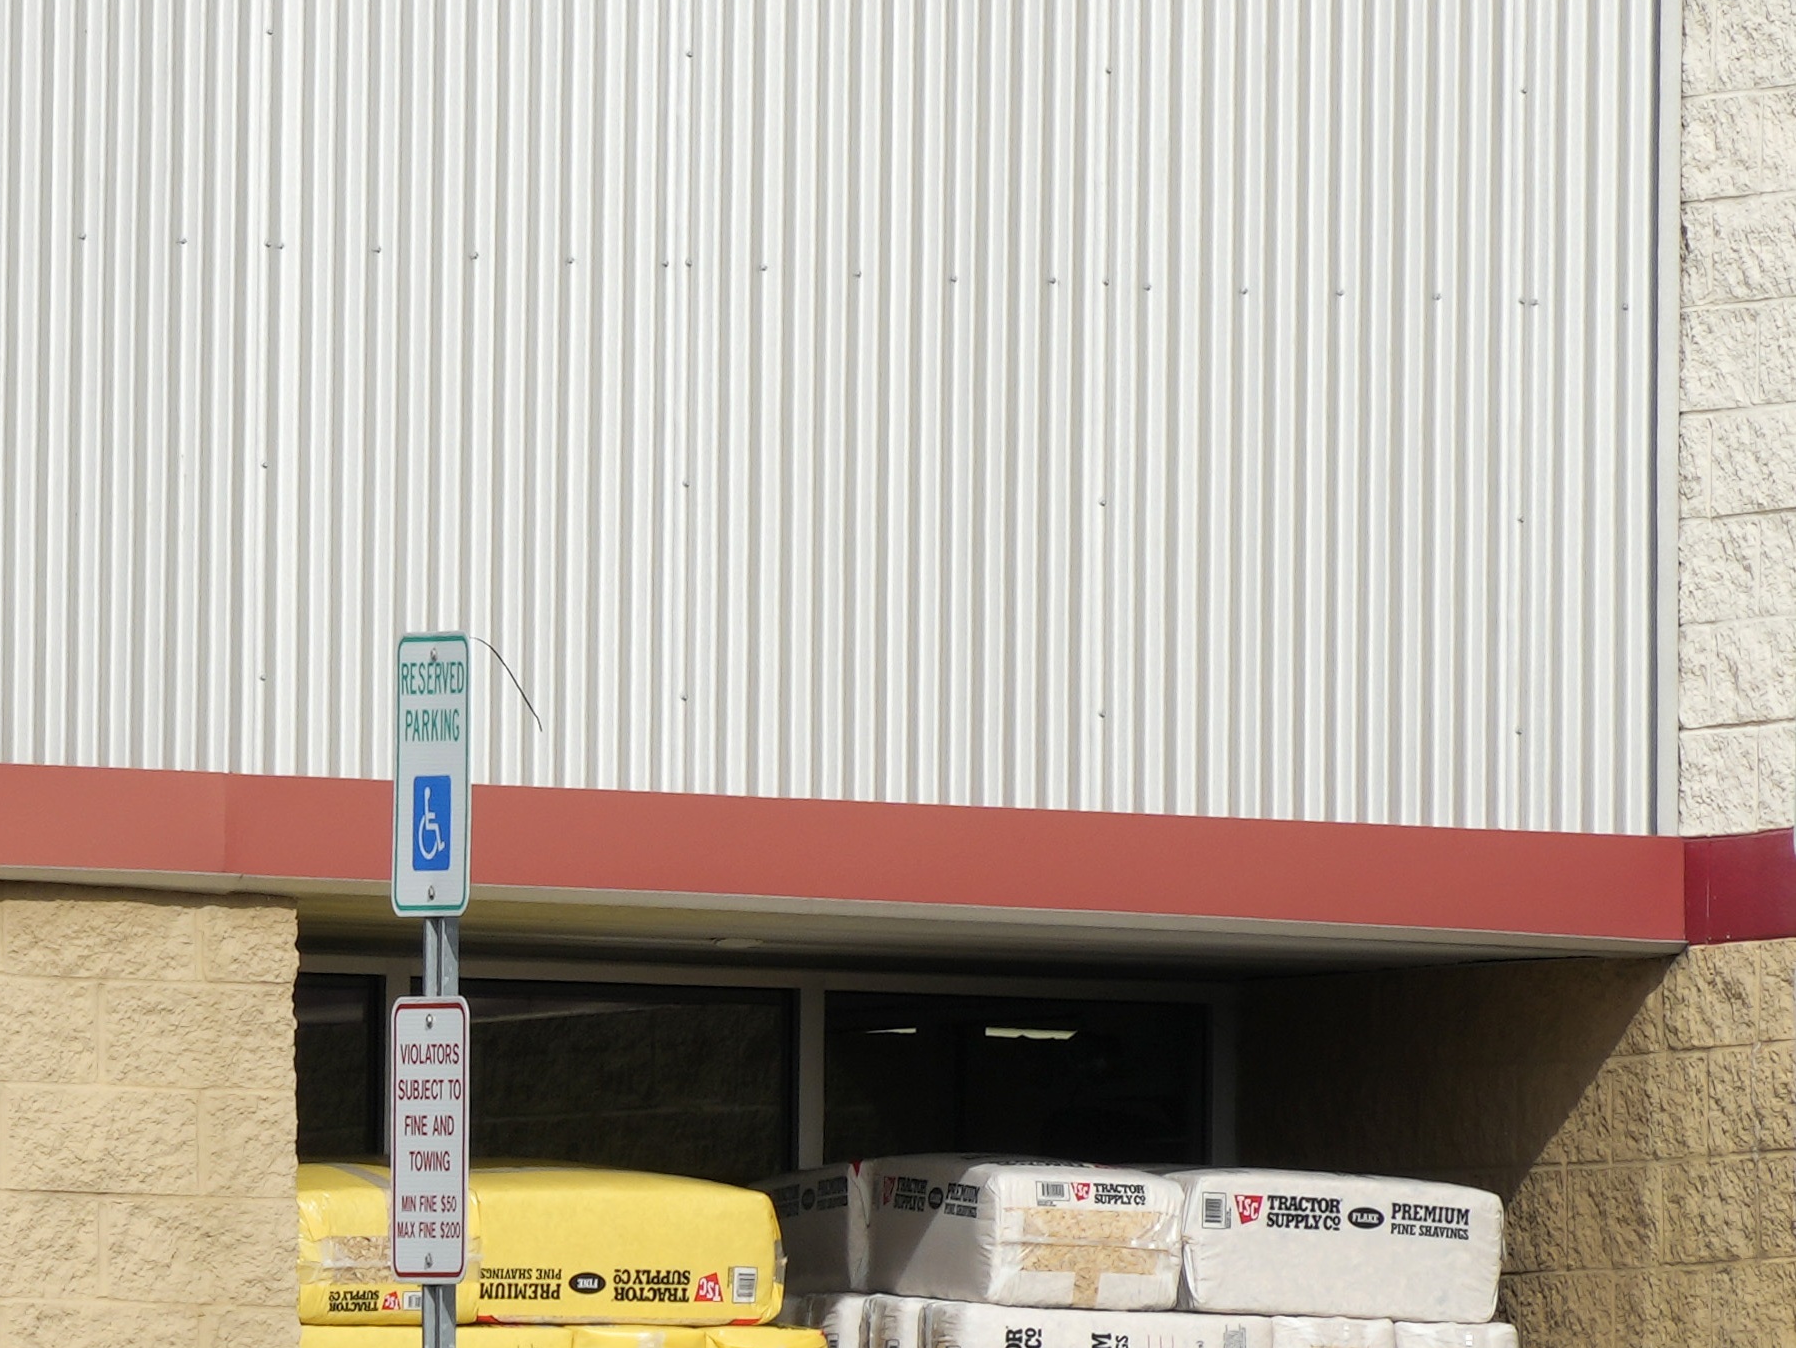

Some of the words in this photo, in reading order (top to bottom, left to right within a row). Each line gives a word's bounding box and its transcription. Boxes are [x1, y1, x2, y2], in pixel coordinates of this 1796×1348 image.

[401, 661, 465, 696] RESERVED
[405, 709, 460, 742] PARKING
[400, 1043, 460, 1065] VIOLATORS
[398, 1079, 445, 1100] SUBJECT
[447, 1079, 461, 1100] TO
[404, 1115, 428, 1136] FINE
[432, 1115, 454, 1136] AND
[409, 1151, 450, 1172] TOWING
[401, 1195, 417, 1213] MIN
[419, 1195, 437, 1213] FINE
[440, 1194, 457, 1214] $50
[1236, 1195, 1260, 1220] TSC
[1267, 1195, 1341, 1214] TRACTOR
[1391, 1202, 1469, 1226] PREMIUM
[397, 1221, 415, 1239] MAX
[419, 1221, 437, 1239] FINE
[440, 1221, 461, 1240] $200
[1266, 1212, 1320, 1230] SUPPLY
[1390, 1223, 1415, 1236] PINE
[1418, 1225, 1469, 1240] SHAVINGS
[480, 1268, 533, 1280] SHAVINGS
[535, 1268, 562, 1280] PINE
[633, 1269, 691, 1285] SUPPLY
[479, 1282, 561, 1300] PREMIUM
[614, 1286, 690, 1303] TRACTOR
[698, 1277, 722, 1301] TSC
